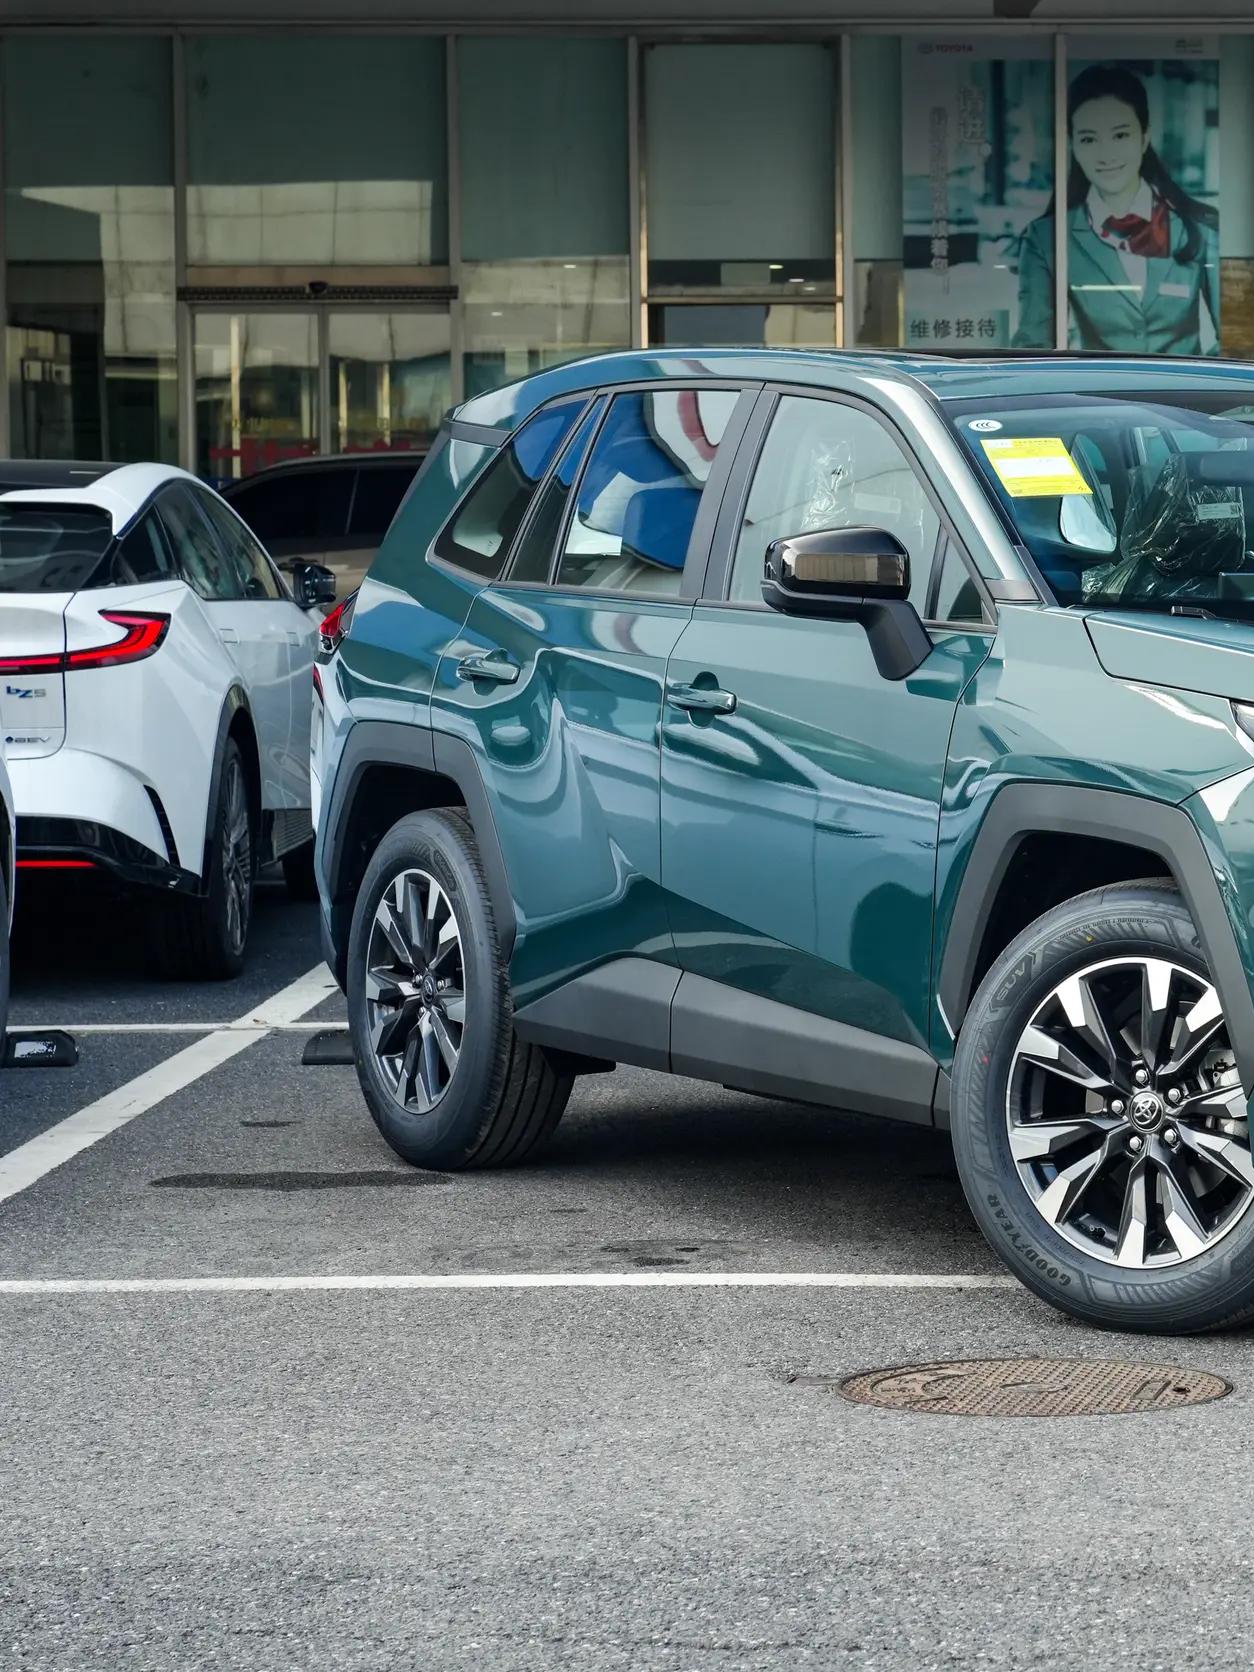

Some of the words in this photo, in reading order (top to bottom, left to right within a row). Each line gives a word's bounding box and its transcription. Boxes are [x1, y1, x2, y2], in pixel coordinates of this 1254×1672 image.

[909, 317, 997, 339] 维修接待
[986, 1192, 1072, 1287] GOODYEAR
